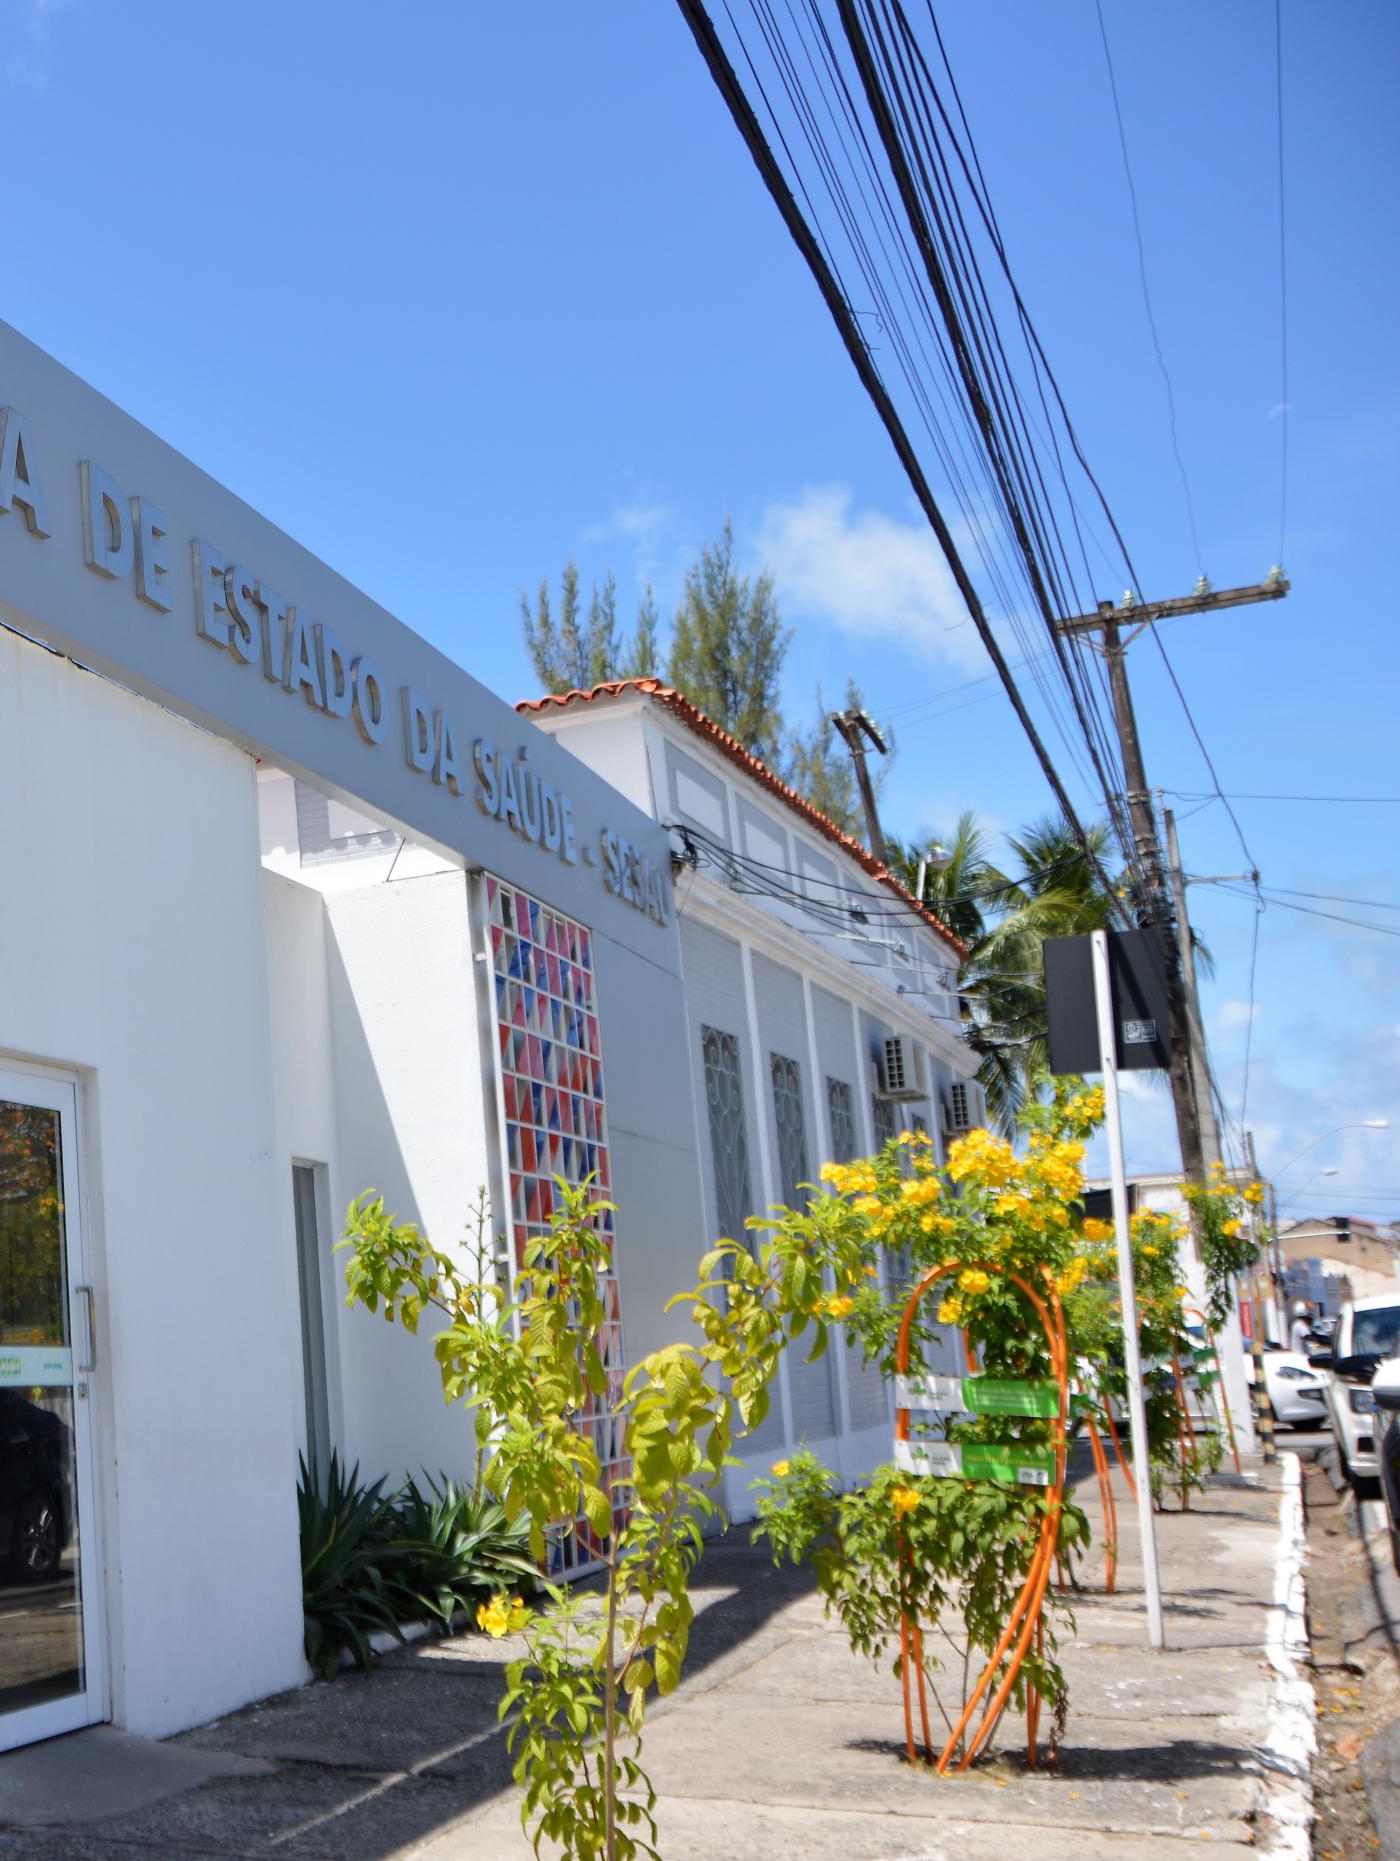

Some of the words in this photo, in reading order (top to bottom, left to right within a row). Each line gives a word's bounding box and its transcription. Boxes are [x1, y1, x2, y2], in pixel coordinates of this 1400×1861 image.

[79, 458, 171, 612] DE
[191, 537, 388, 745] ESTADO
[403, 685, 464, 796] DA
[474, 738, 576, 866] SAÚDE
